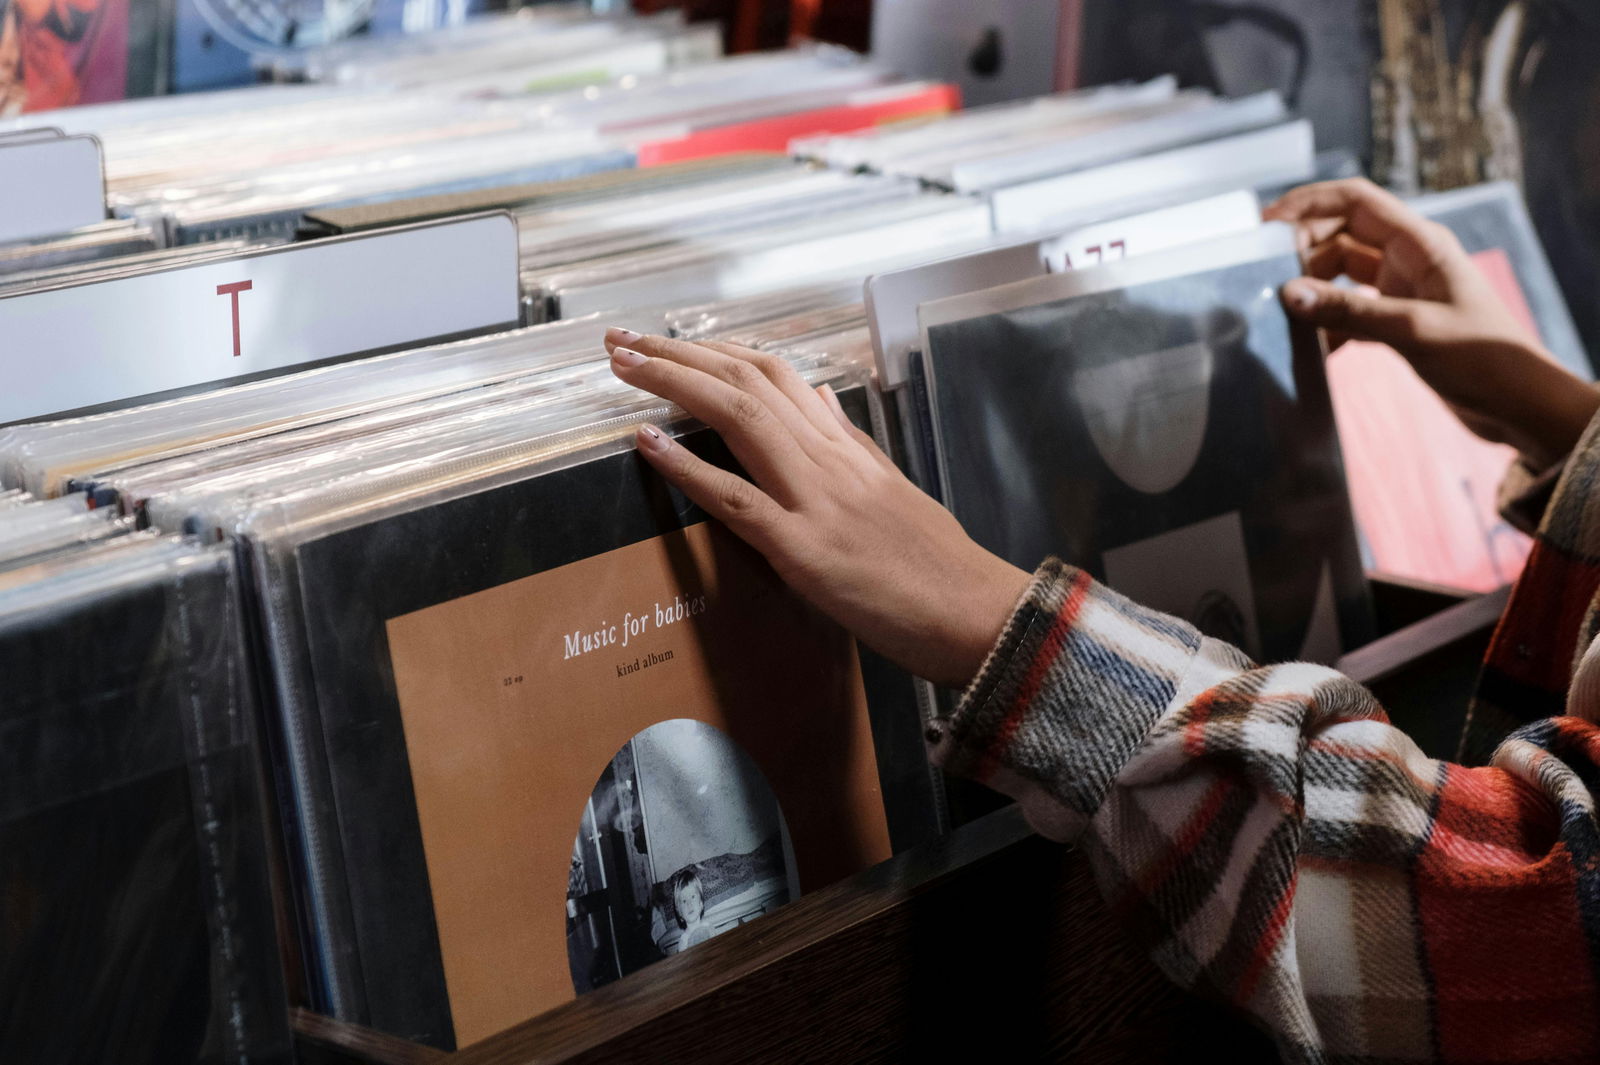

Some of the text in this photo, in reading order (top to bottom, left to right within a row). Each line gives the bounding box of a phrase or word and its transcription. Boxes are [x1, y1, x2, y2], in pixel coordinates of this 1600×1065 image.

[216, 279, 253, 357] T
[563, 594, 706, 660] Music for babies
[616, 648, 674, 678] kind album
